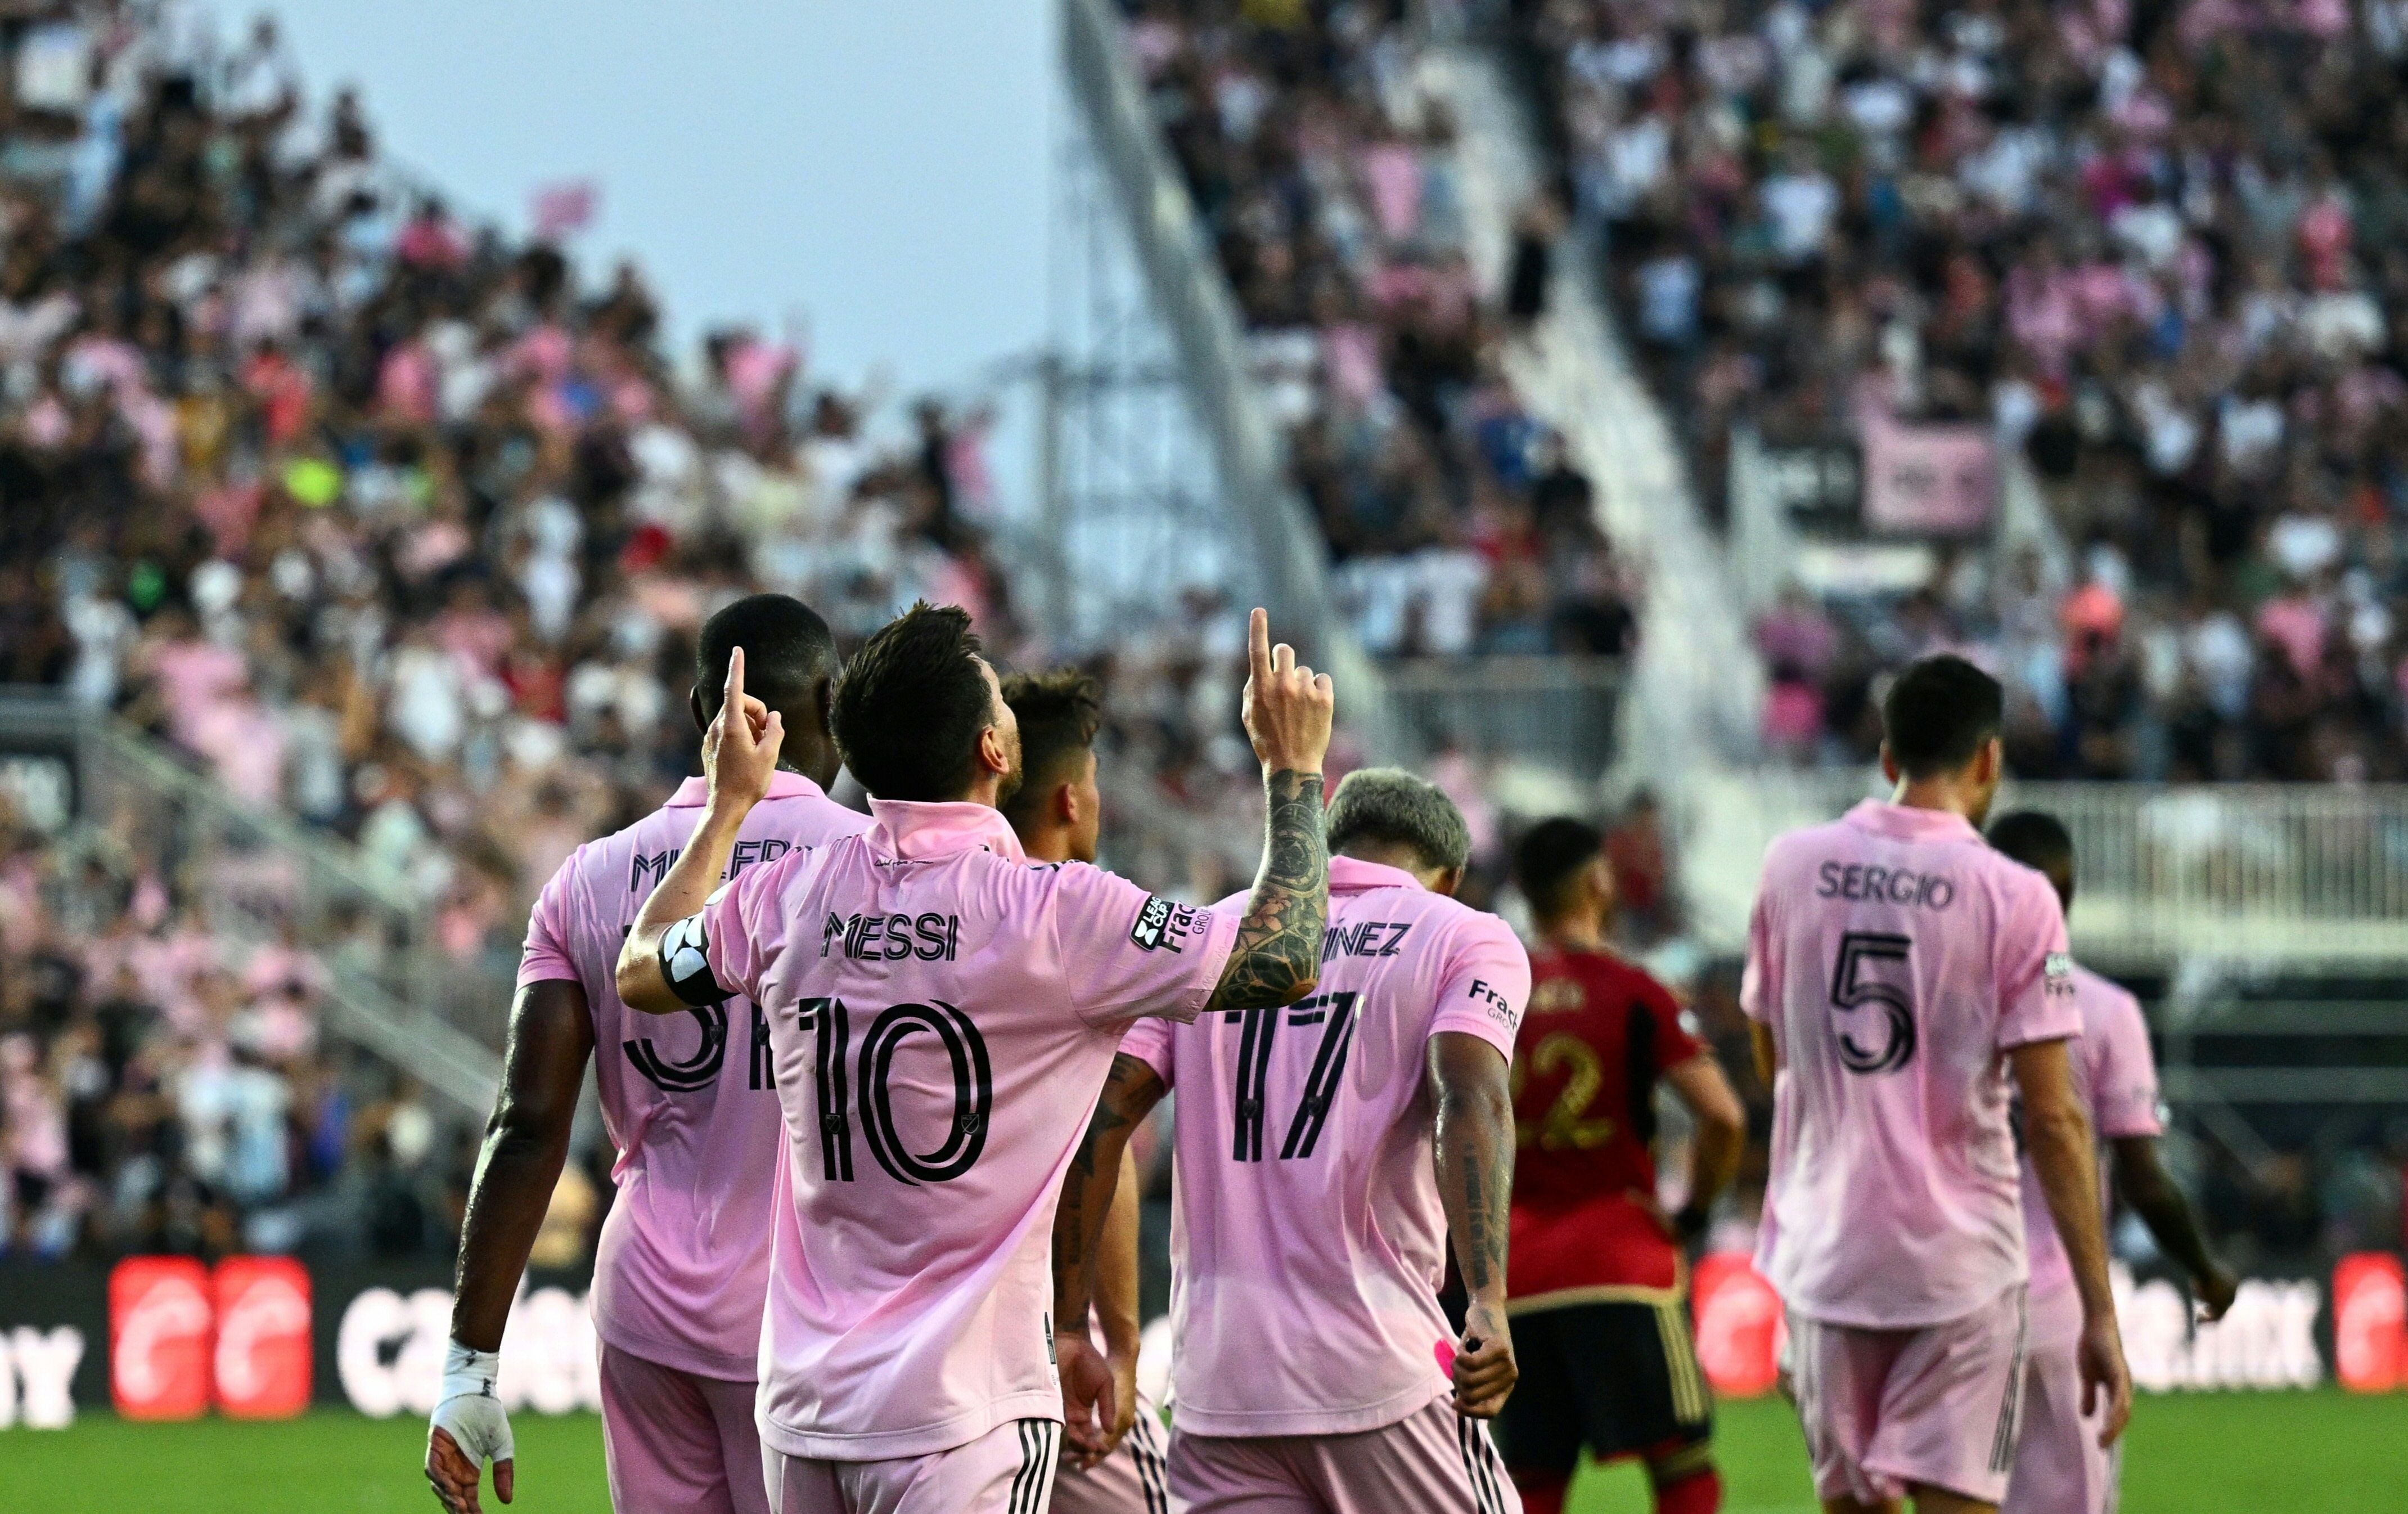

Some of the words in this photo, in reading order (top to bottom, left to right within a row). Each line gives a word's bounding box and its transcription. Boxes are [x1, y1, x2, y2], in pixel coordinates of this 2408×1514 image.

[1817, 859, 1953, 911] SERGIO
[821, 911, 957, 961] MESSI
[1153, 904, 1168, 927] CUP
[1158, 904, 1196, 954] Frac
[1831, 931, 1916, 1075] 5
[799, 998, 992, 1187] 10
[1225, 992, 1359, 1162] 17
